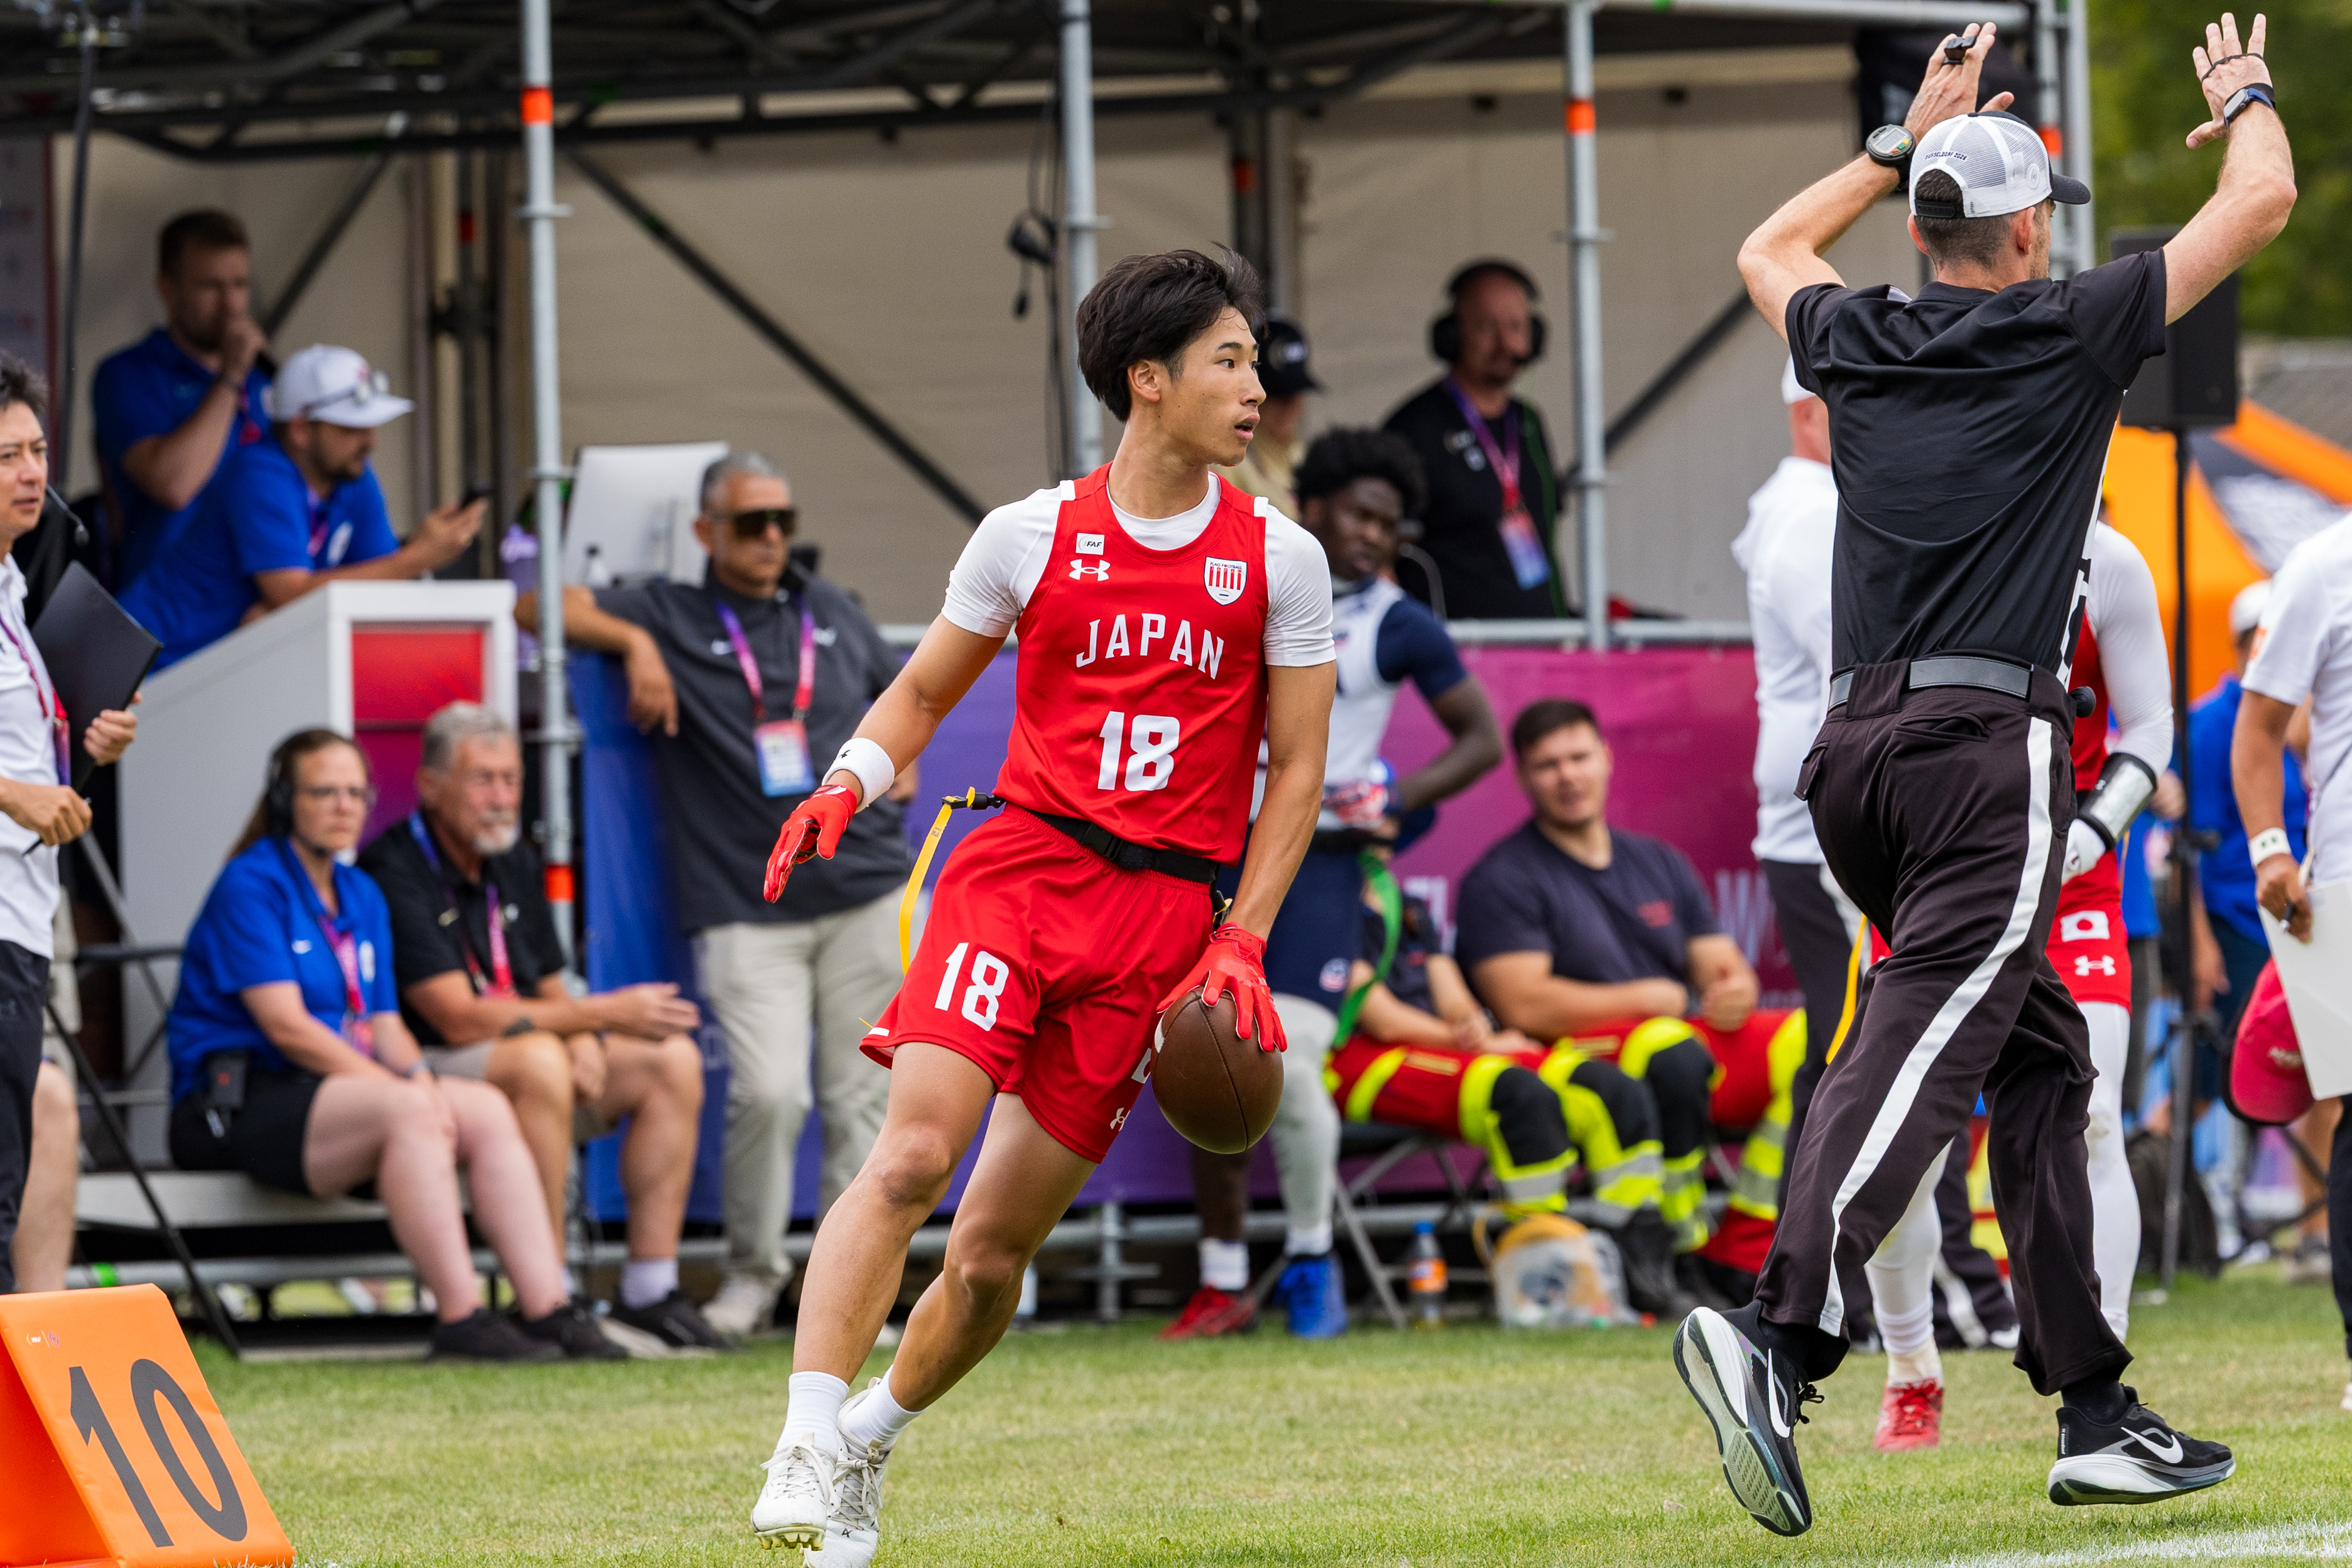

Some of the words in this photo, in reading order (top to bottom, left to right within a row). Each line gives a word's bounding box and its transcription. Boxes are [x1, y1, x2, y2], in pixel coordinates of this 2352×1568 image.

[1076, 613, 1224, 680] JAPAN
[1097, 710, 1180, 792] 18
[934, 942, 1010, 1032] 18
[68, 1358, 248, 1548] 10
